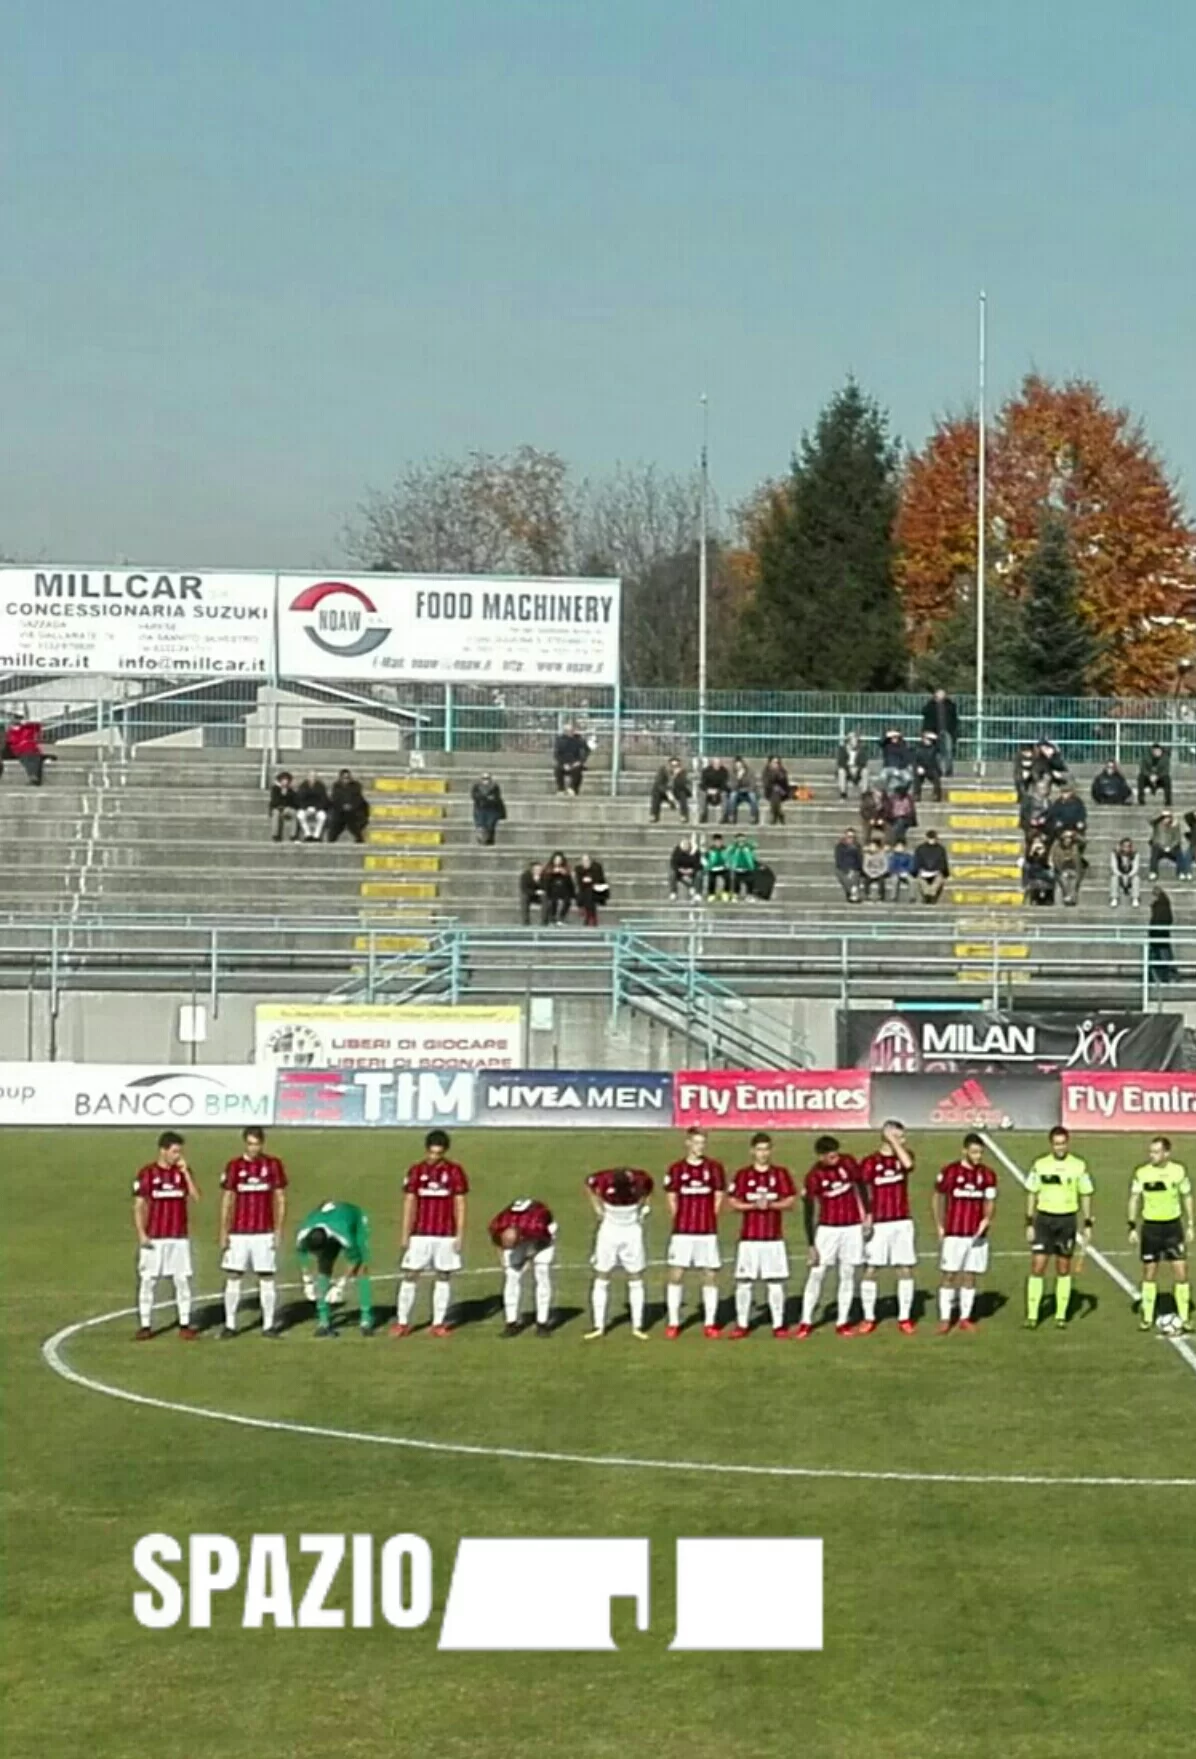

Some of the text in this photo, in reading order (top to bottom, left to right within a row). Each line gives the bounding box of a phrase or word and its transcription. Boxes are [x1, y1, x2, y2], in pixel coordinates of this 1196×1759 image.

[34, 573, 203, 599] MILLCAR
[6, 602, 268, 620] CONCESSIONARIA SUZUKI
[416, 590, 613, 623] FOOD MACHINERY
[118, 655, 266, 671] info@millcar.it
[331, 1038, 508, 1051] LIBERI DI GIOCARE
[922, 1023, 1035, 1053] MILAN
[74, 1092, 270, 1117] BANCO BPM
[354, 1072, 475, 1122] TIM
[487, 1086, 662, 1109] NIVEA MEN
[679, 1084, 867, 1113] Fly Emirates
[1067, 1085, 1117, 1116] Fly
